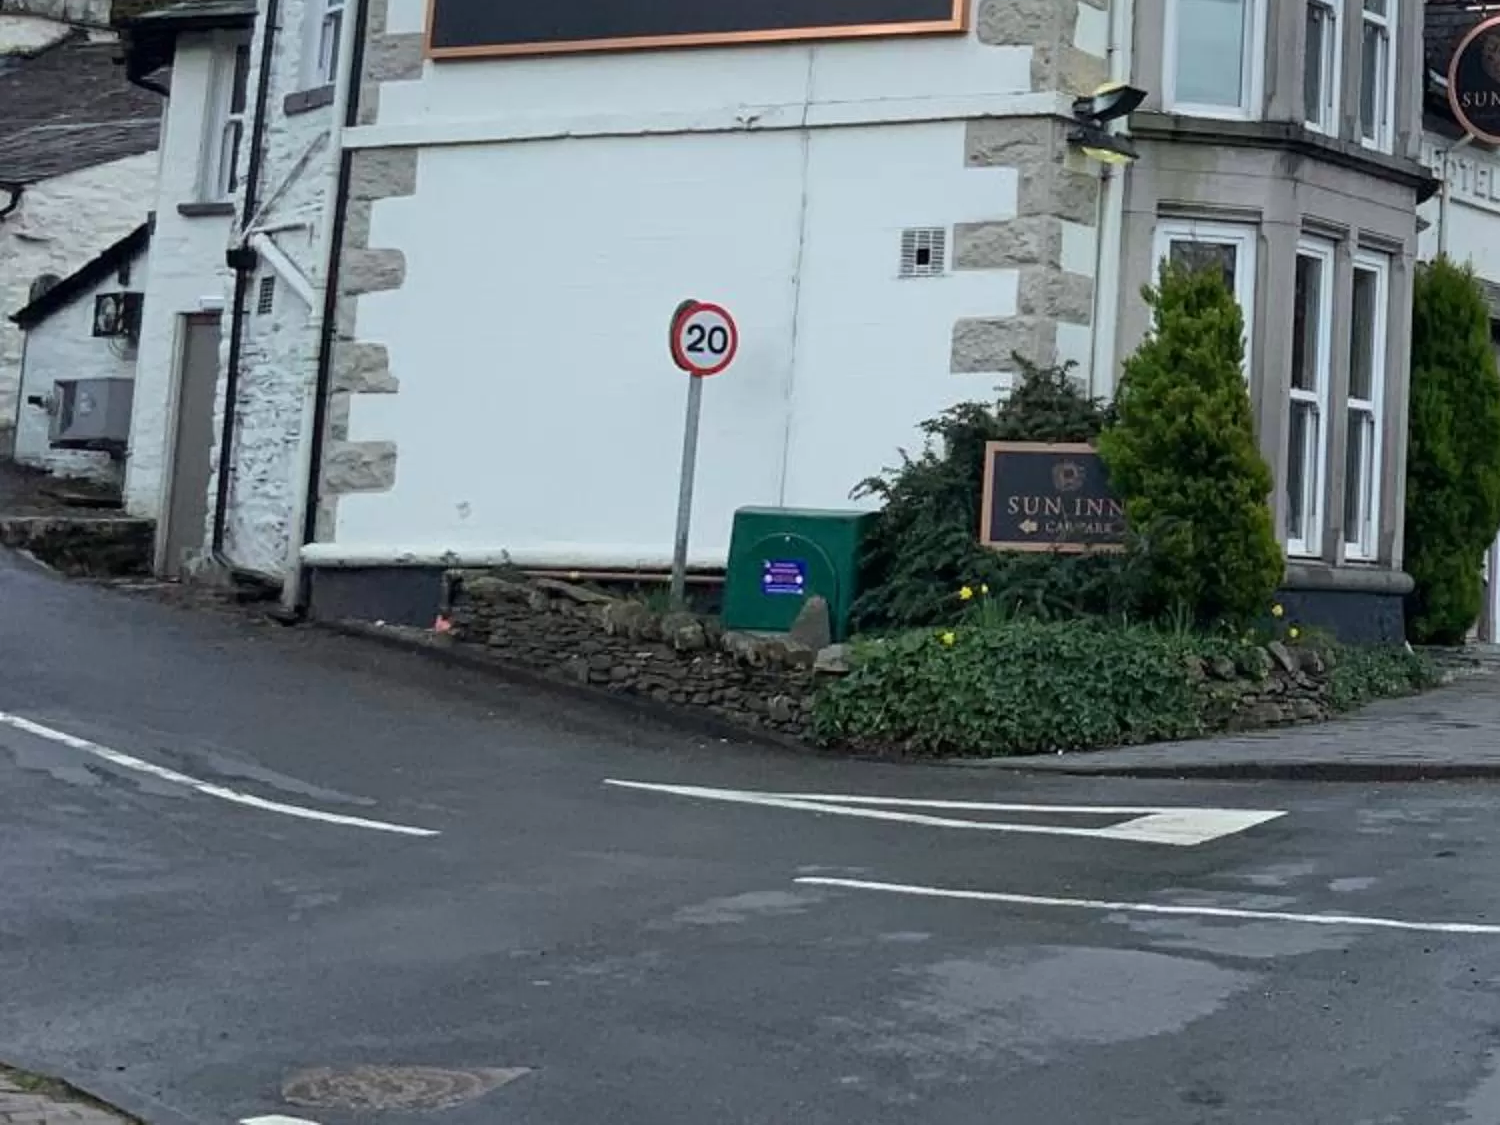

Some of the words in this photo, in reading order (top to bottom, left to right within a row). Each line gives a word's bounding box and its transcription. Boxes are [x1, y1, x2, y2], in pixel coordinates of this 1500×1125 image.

[687, 323, 728, 355] 20
[1007, 496, 1061, 516] SUN
[1074, 498, 1126, 516] INN
